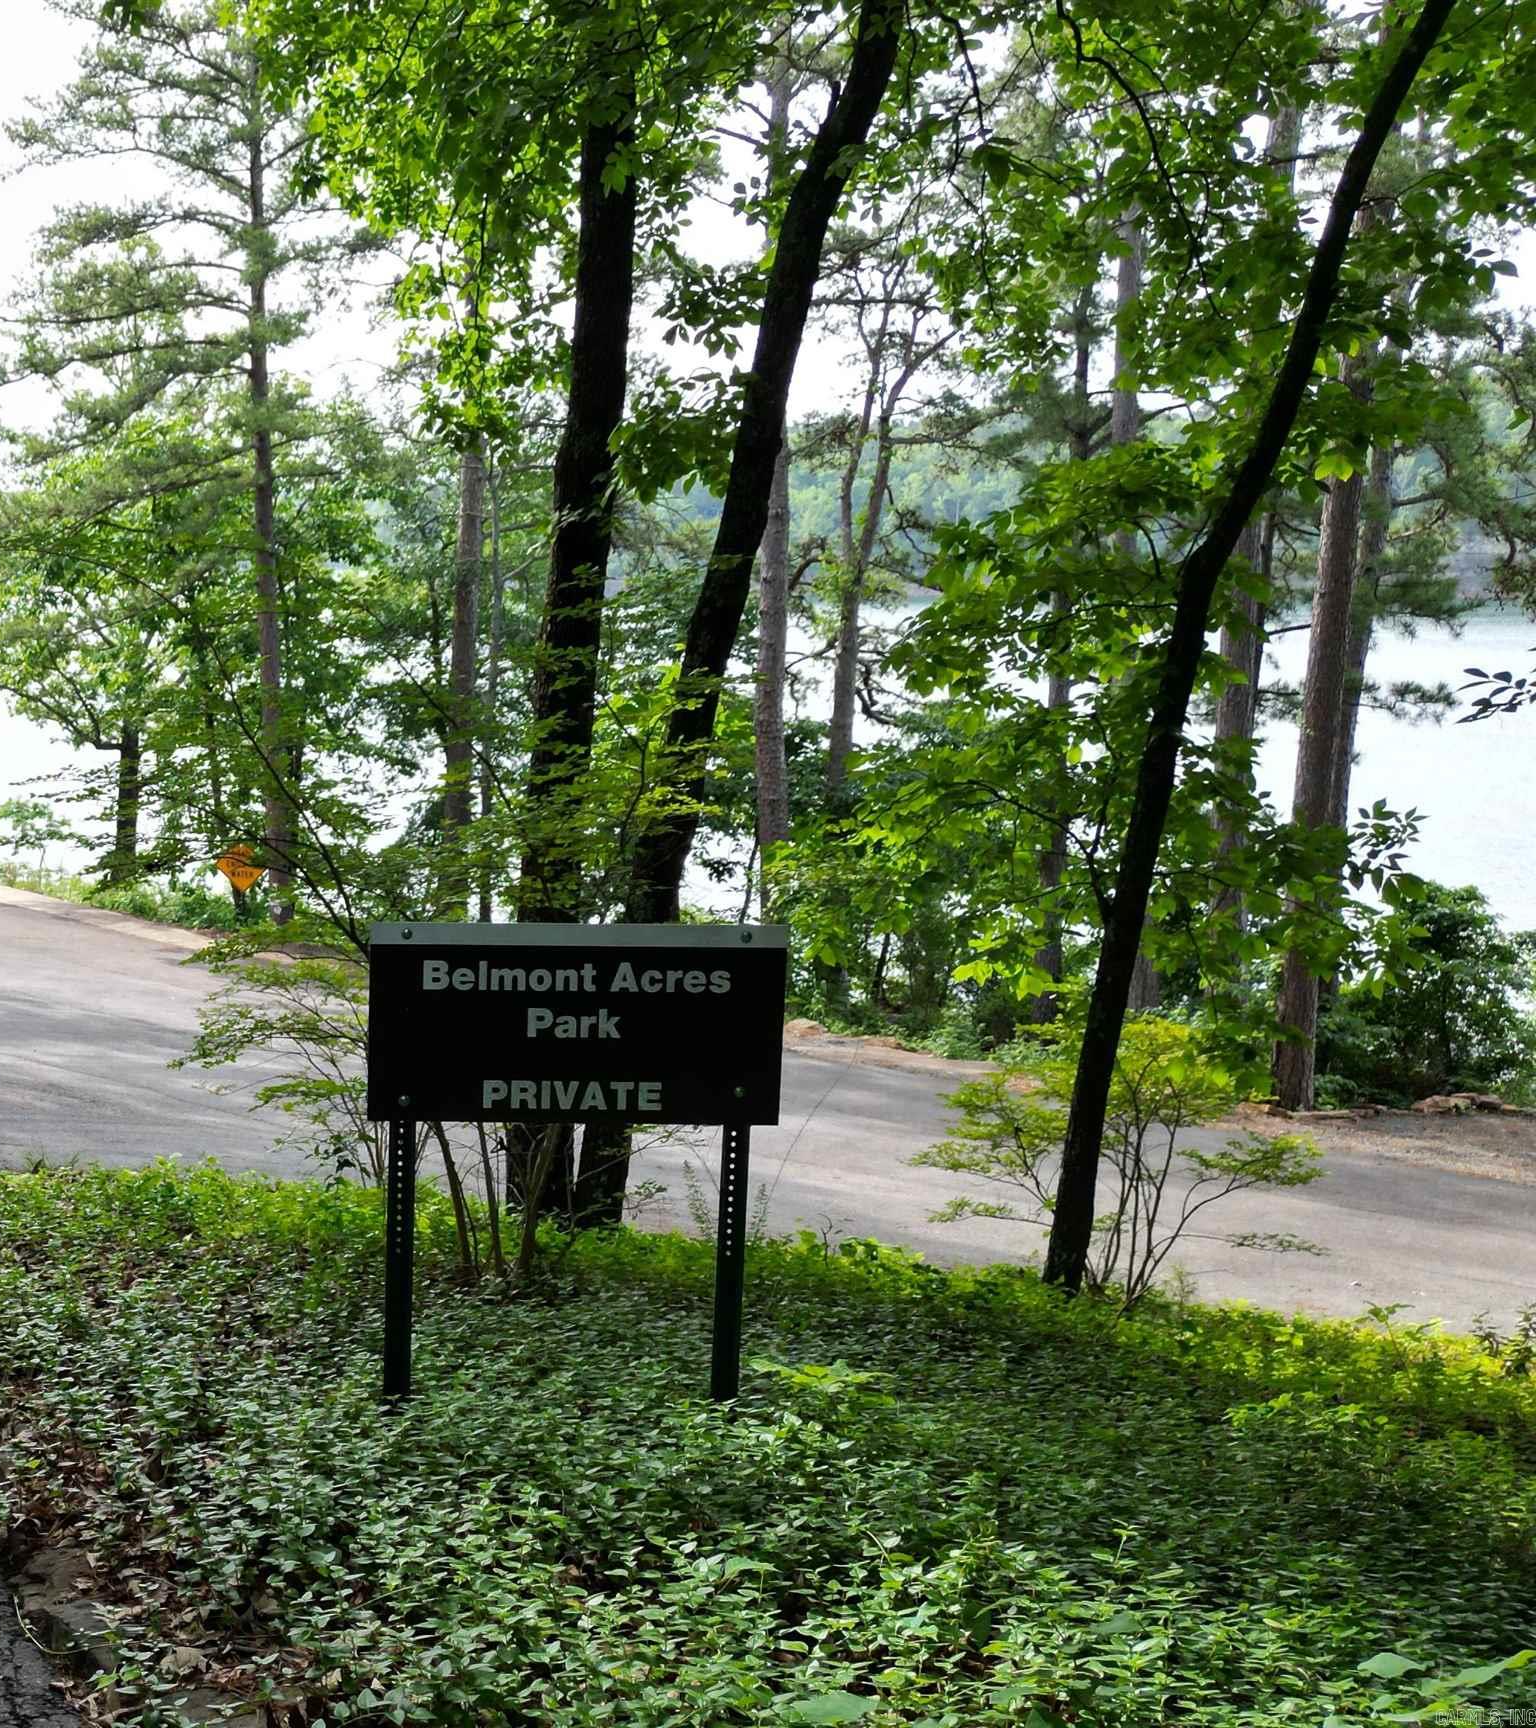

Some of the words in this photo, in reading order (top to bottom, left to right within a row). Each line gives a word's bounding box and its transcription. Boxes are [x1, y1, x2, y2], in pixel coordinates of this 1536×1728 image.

[422, 959, 597, 992] Belmont
[610, 961, 731, 994] Acres
[526, 1007, 621, 1039] Park
[482, 1079, 662, 1111] PRIVATE
